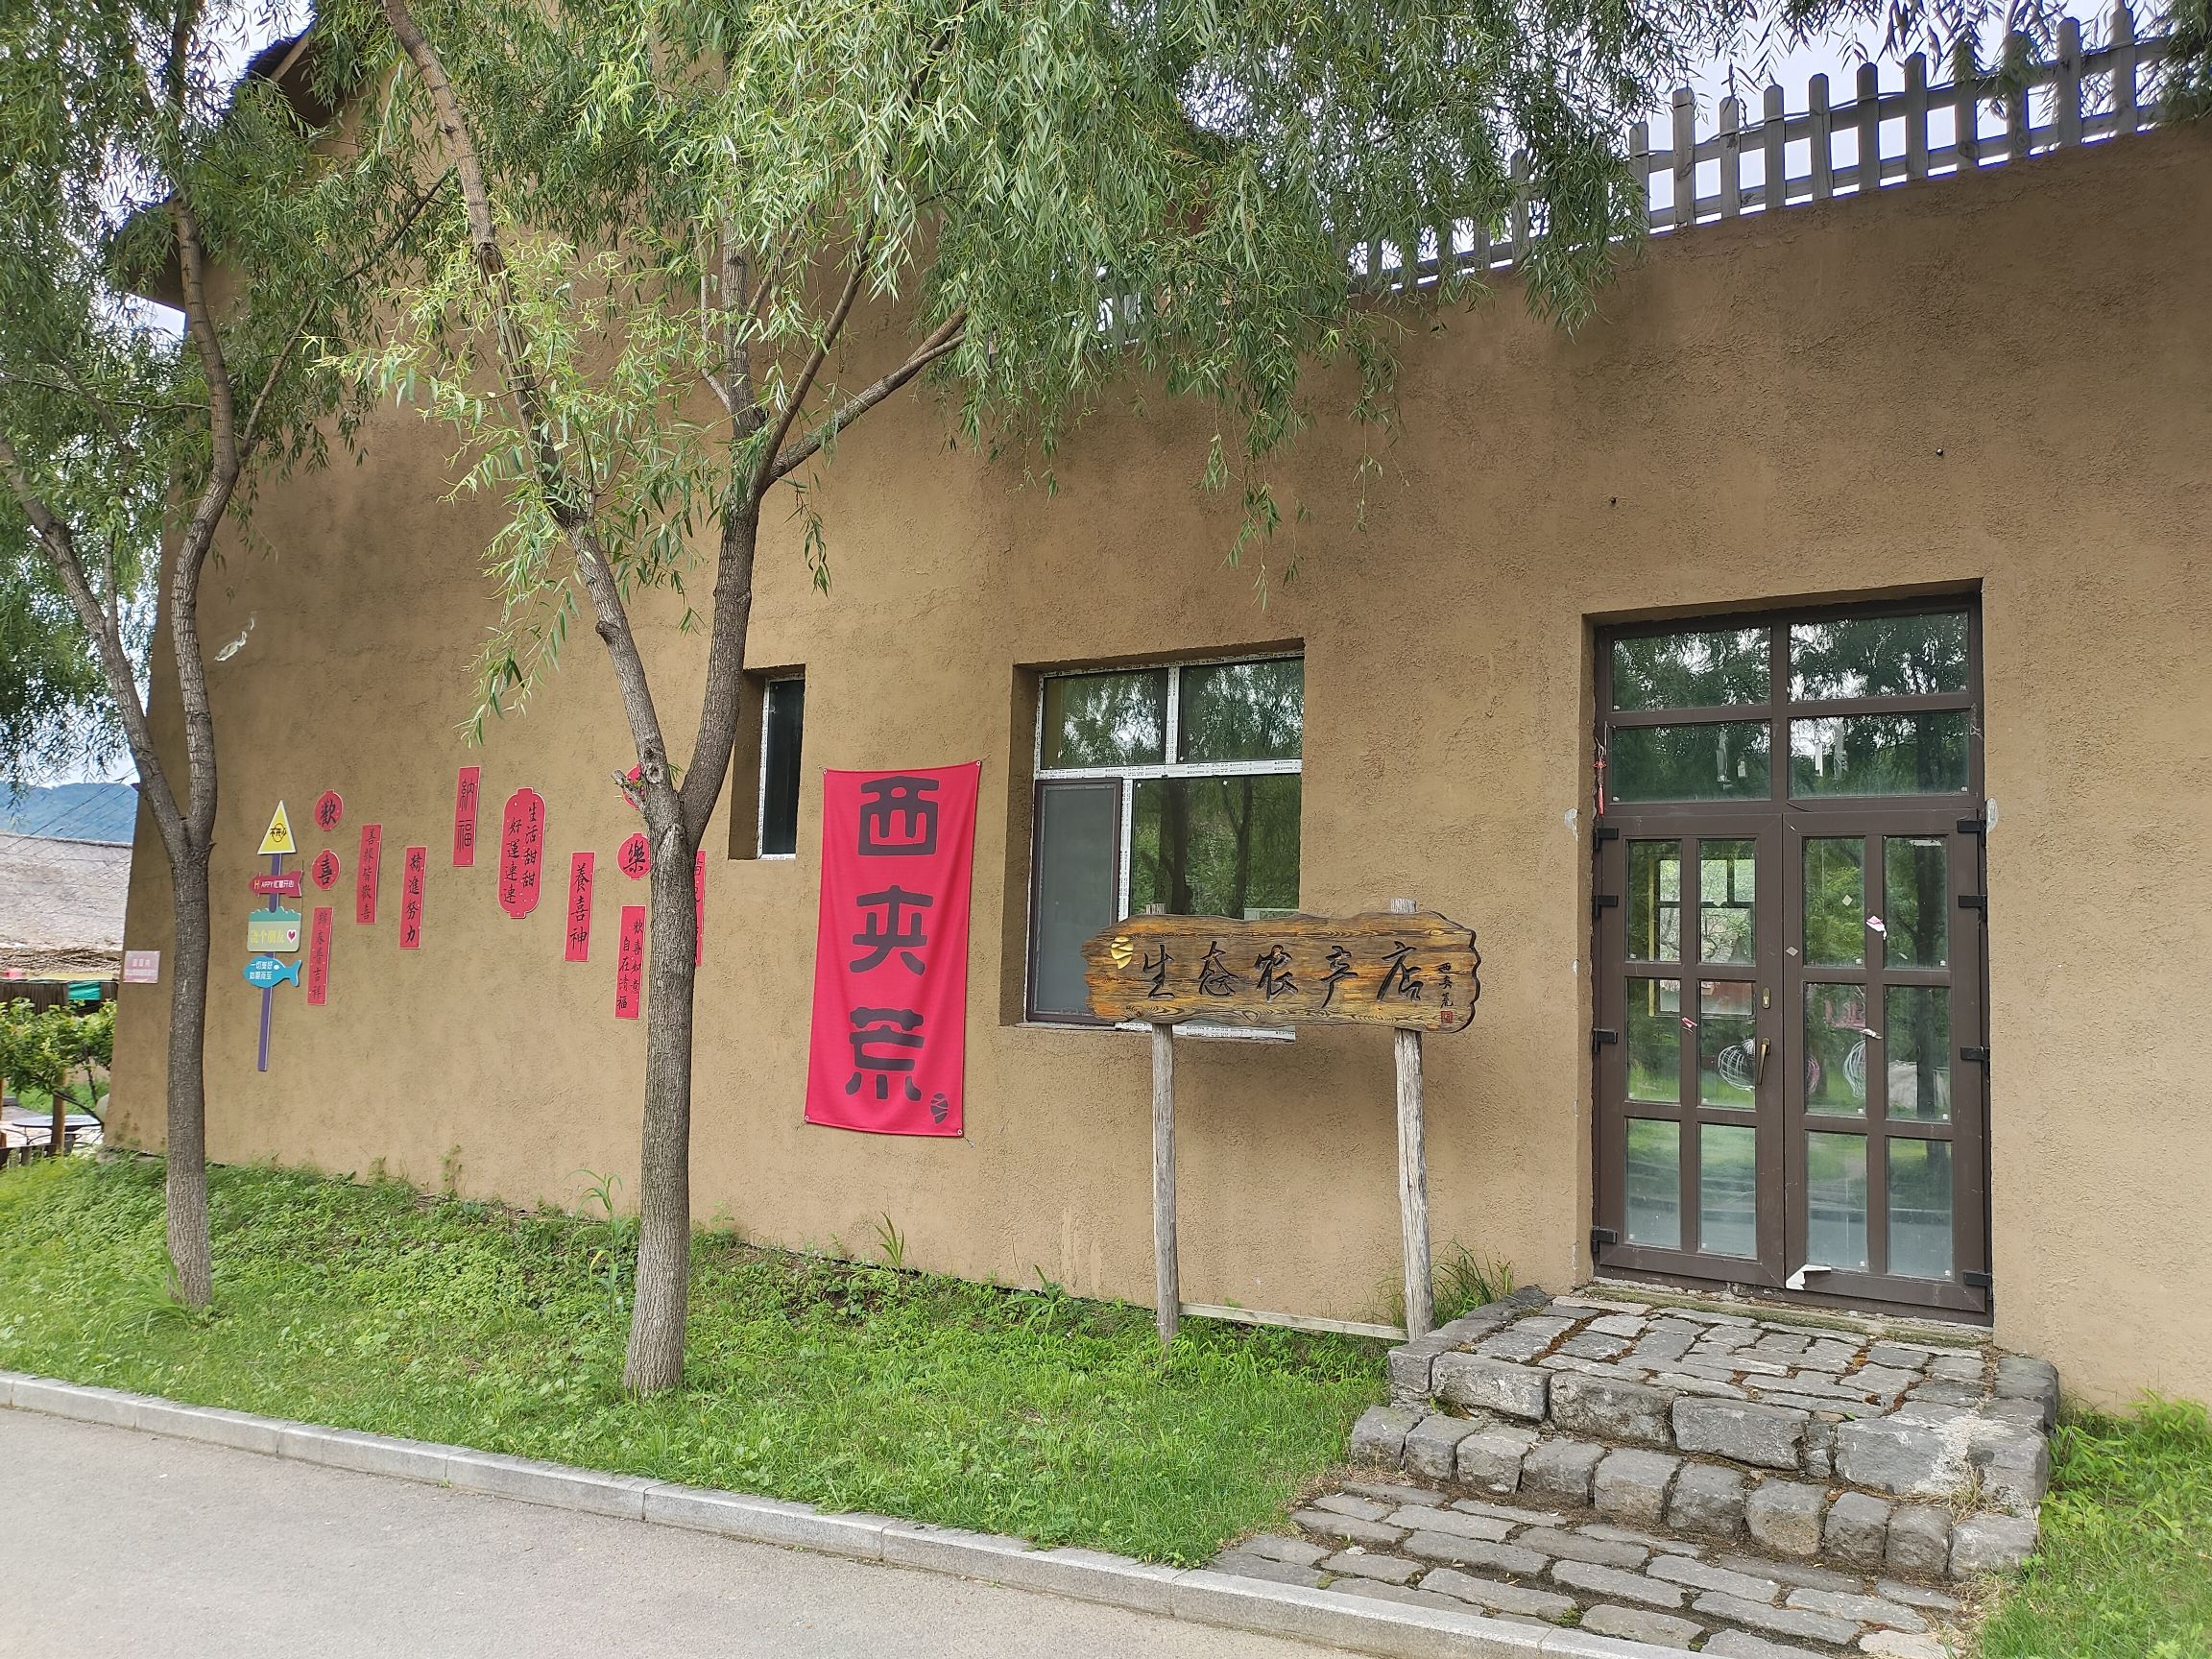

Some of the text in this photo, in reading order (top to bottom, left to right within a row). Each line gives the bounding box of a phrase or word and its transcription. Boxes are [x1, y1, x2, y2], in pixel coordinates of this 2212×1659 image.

[318, 854, 332, 885] 喜
[521, 801, 538, 889] 生活甜甜
